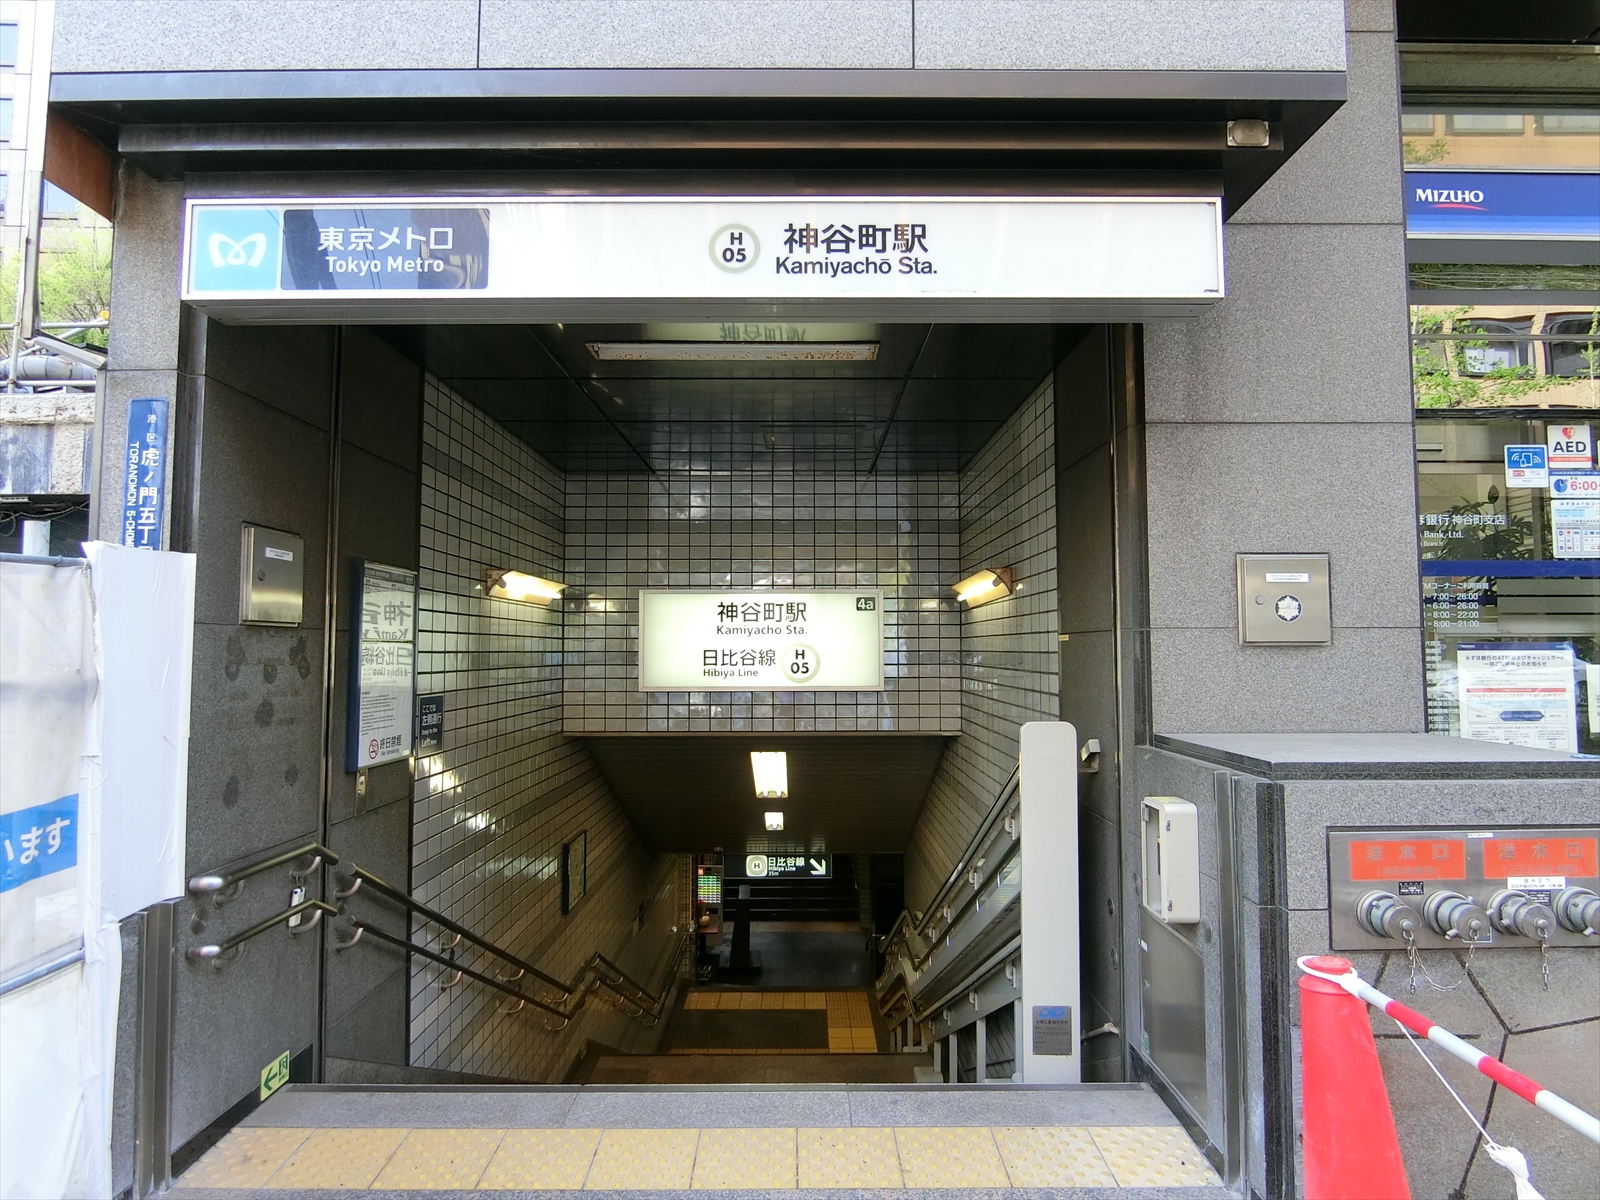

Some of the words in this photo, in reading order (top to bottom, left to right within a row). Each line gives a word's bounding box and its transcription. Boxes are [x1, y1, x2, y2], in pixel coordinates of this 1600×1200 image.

[1416, 189, 1484, 203] MIZUHO
[318, 227, 453, 251] 東京メトロ
[730, 232, 743, 246] H
[783, 223, 929, 254] 神谷町駅
[722, 248, 747, 263] 05
[325, 256, 382, 276] Tokyo
[387, 256, 445, 273] Metro
[775, 257, 892, 278] Kamiyachō
[898, 257, 938, 274] Sta.
[146, 414, 158, 442] 港区
[1553, 441, 1587, 453] AED
[127, 441, 140, 507] TORANOMON
[1571, 481, 1600, 491] 6:00
[137, 447, 160, 550] 虎ノ門五丁
[1424, 531, 1447, 539] Bank,
[1449, 531, 1465, 539] Ltd.
[857, 598, 874, 610] 4a
[717, 602, 807, 623] 神谷町駅
[717, 625, 782, 637] Kamiyacho
[786, 625, 808, 635] Sta.
[703, 649, 776, 667] 日比谷線
[795, 650, 805, 660] H
[703, 668, 735, 679] Hibiya
[738, 668, 759, 677] Line
[790, 662, 810, 674] 05
[421, 736, 431, 748] Left
[387, 747, 400, 756] Smoking
[1500, 843, 1581, 860] 送水口
[768, 857, 805, 867] 日比谷線
